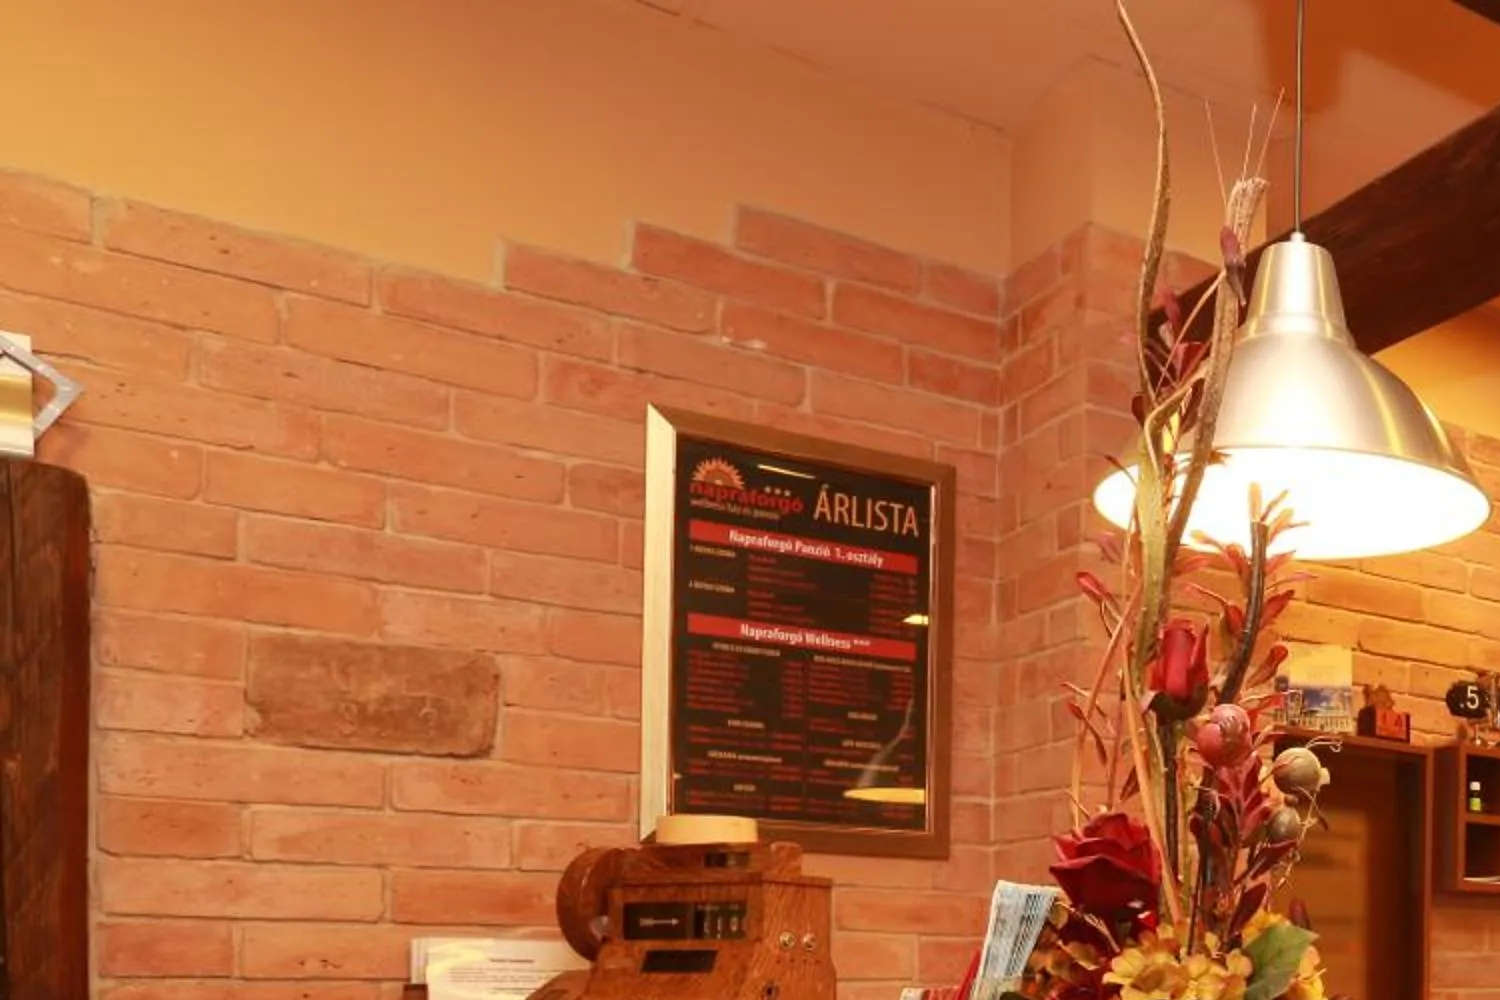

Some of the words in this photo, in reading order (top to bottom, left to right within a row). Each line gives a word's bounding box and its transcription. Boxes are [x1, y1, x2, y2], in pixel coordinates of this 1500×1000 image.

[812, 483, 920, 538] ÁRLISTA
[728, 530, 793, 553] Napraforgó
[739, 623, 804, 645] Napraforgó
[805, 631, 852, 649] Wellness
